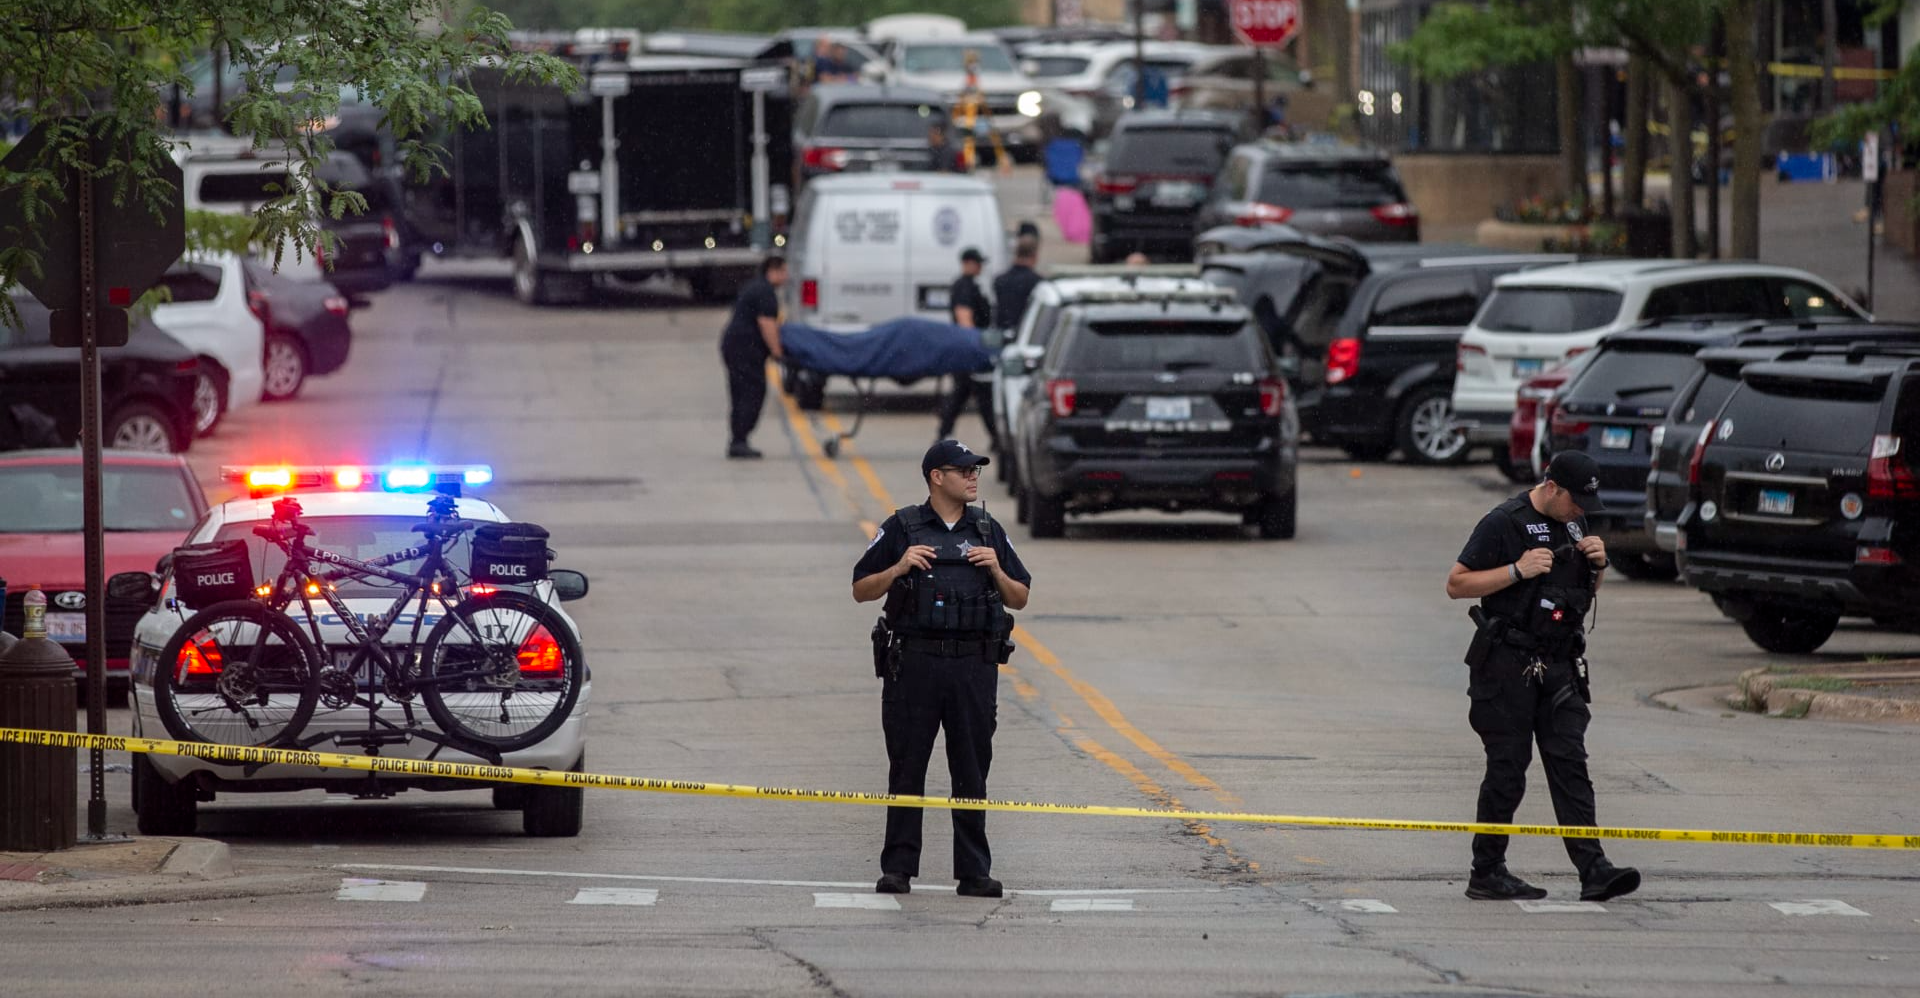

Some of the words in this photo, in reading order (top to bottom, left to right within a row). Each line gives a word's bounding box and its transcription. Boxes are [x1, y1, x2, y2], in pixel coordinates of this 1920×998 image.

[1240, 2, 1292, 29] STOP
[1105, 421, 1232, 431] POLICE
[1526, 523, 1551, 534] POLICE
[314, 549, 340, 562] LPD
[393, 547, 420, 561] LFD
[489, 564, 527, 577] POLICE
[197, 573, 235, 587] POLICE
[290, 613, 443, 626] POLICE
[484, 625, 509, 639] 17
[23, 732, 45, 745] LINE
[49, 733, 64, 746] DO
[67, 735, 88, 748] NOT
[91, 736, 126, 751] CROSS
[178, 743, 214, 757] POLICE
[218, 746, 240, 759] LINE
[244, 748, 258, 761] DO
[262, 750, 282, 763] NOT
[286, 751, 320, 766] CROSS
[371, 758, 408, 771] POLICE
[412, 761, 434, 773] LINE
[438, 763, 451, 775] DO
[455, 765, 475, 776] NOT
[479, 766, 513, 778] CROSS
[564, 773, 600, 783] POLICE
[604, 775, 627, 785] LINE
[630, 777, 644, 787] DO
[648, 779, 667, 788] NOT
